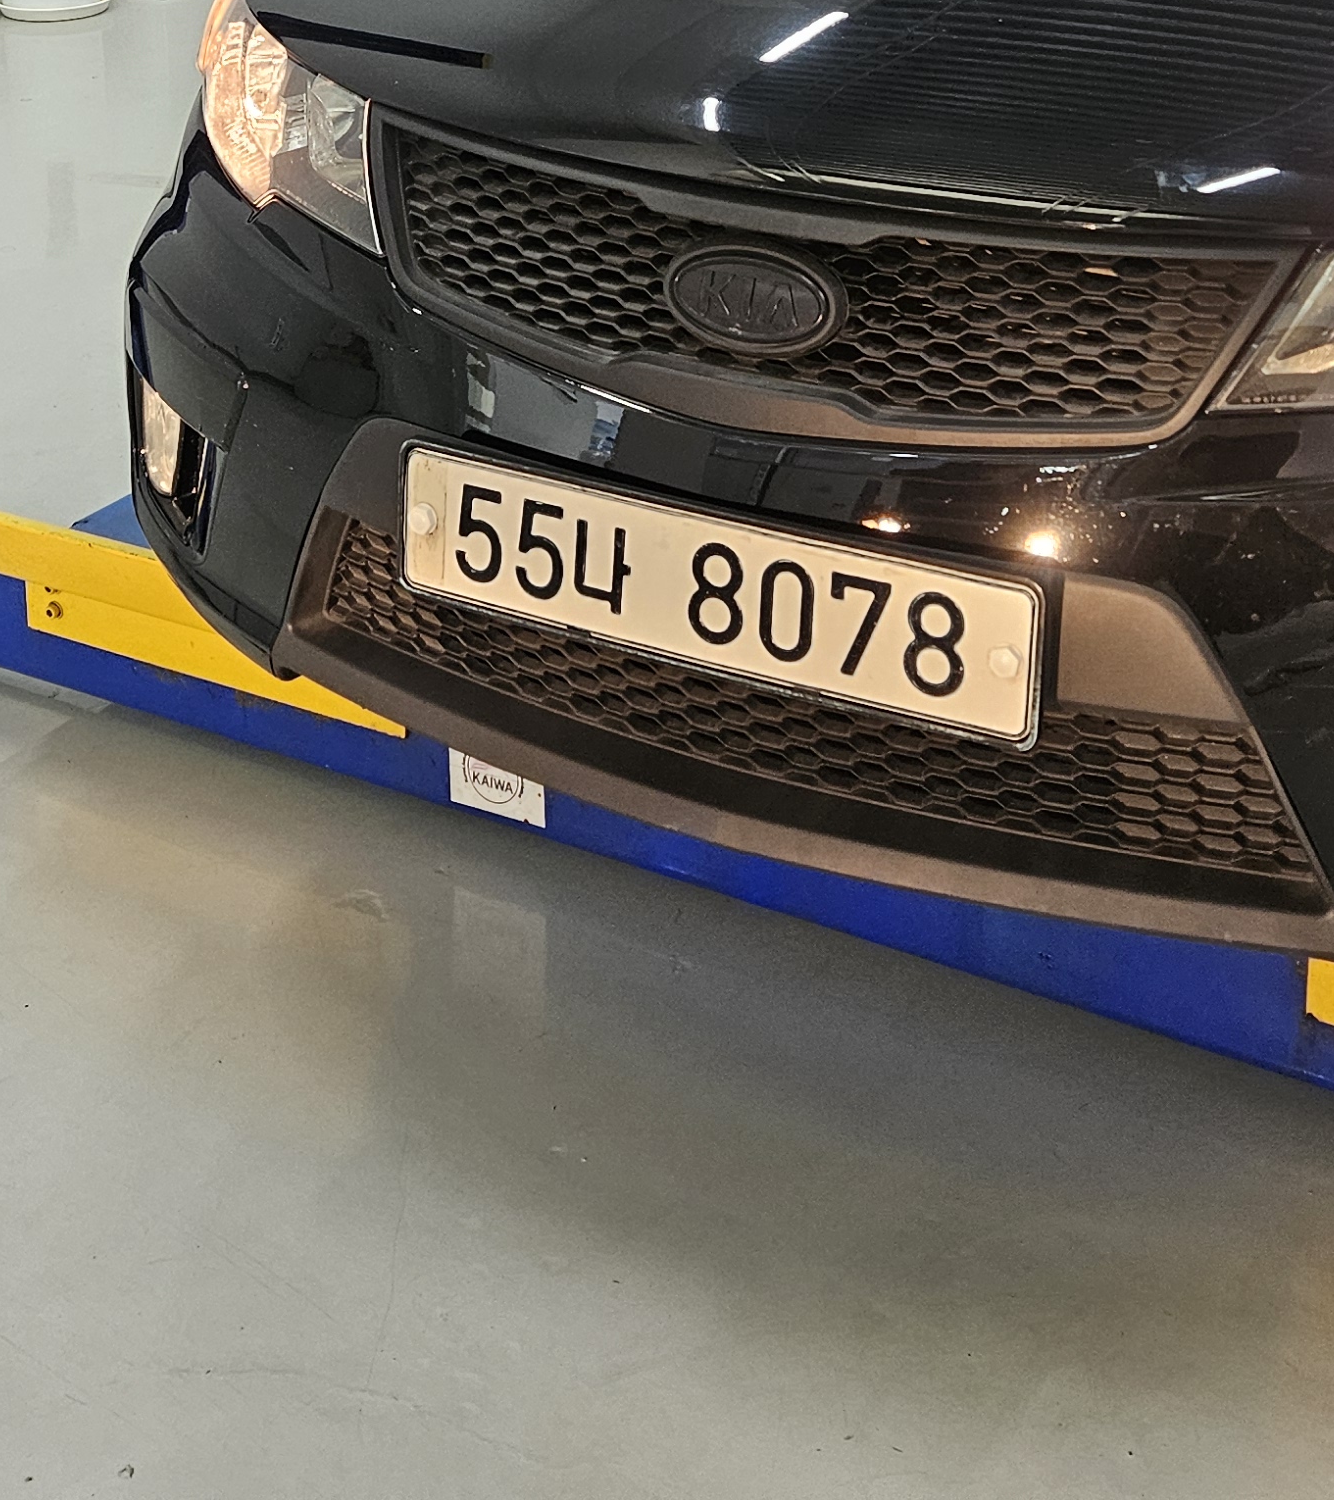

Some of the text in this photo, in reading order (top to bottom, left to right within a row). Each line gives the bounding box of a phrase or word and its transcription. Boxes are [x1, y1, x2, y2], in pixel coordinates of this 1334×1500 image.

[697, 270, 799, 327] KIA
[455, 483, 965, 698] 55나 8078
[472, 770, 513, 794] KAIWA
